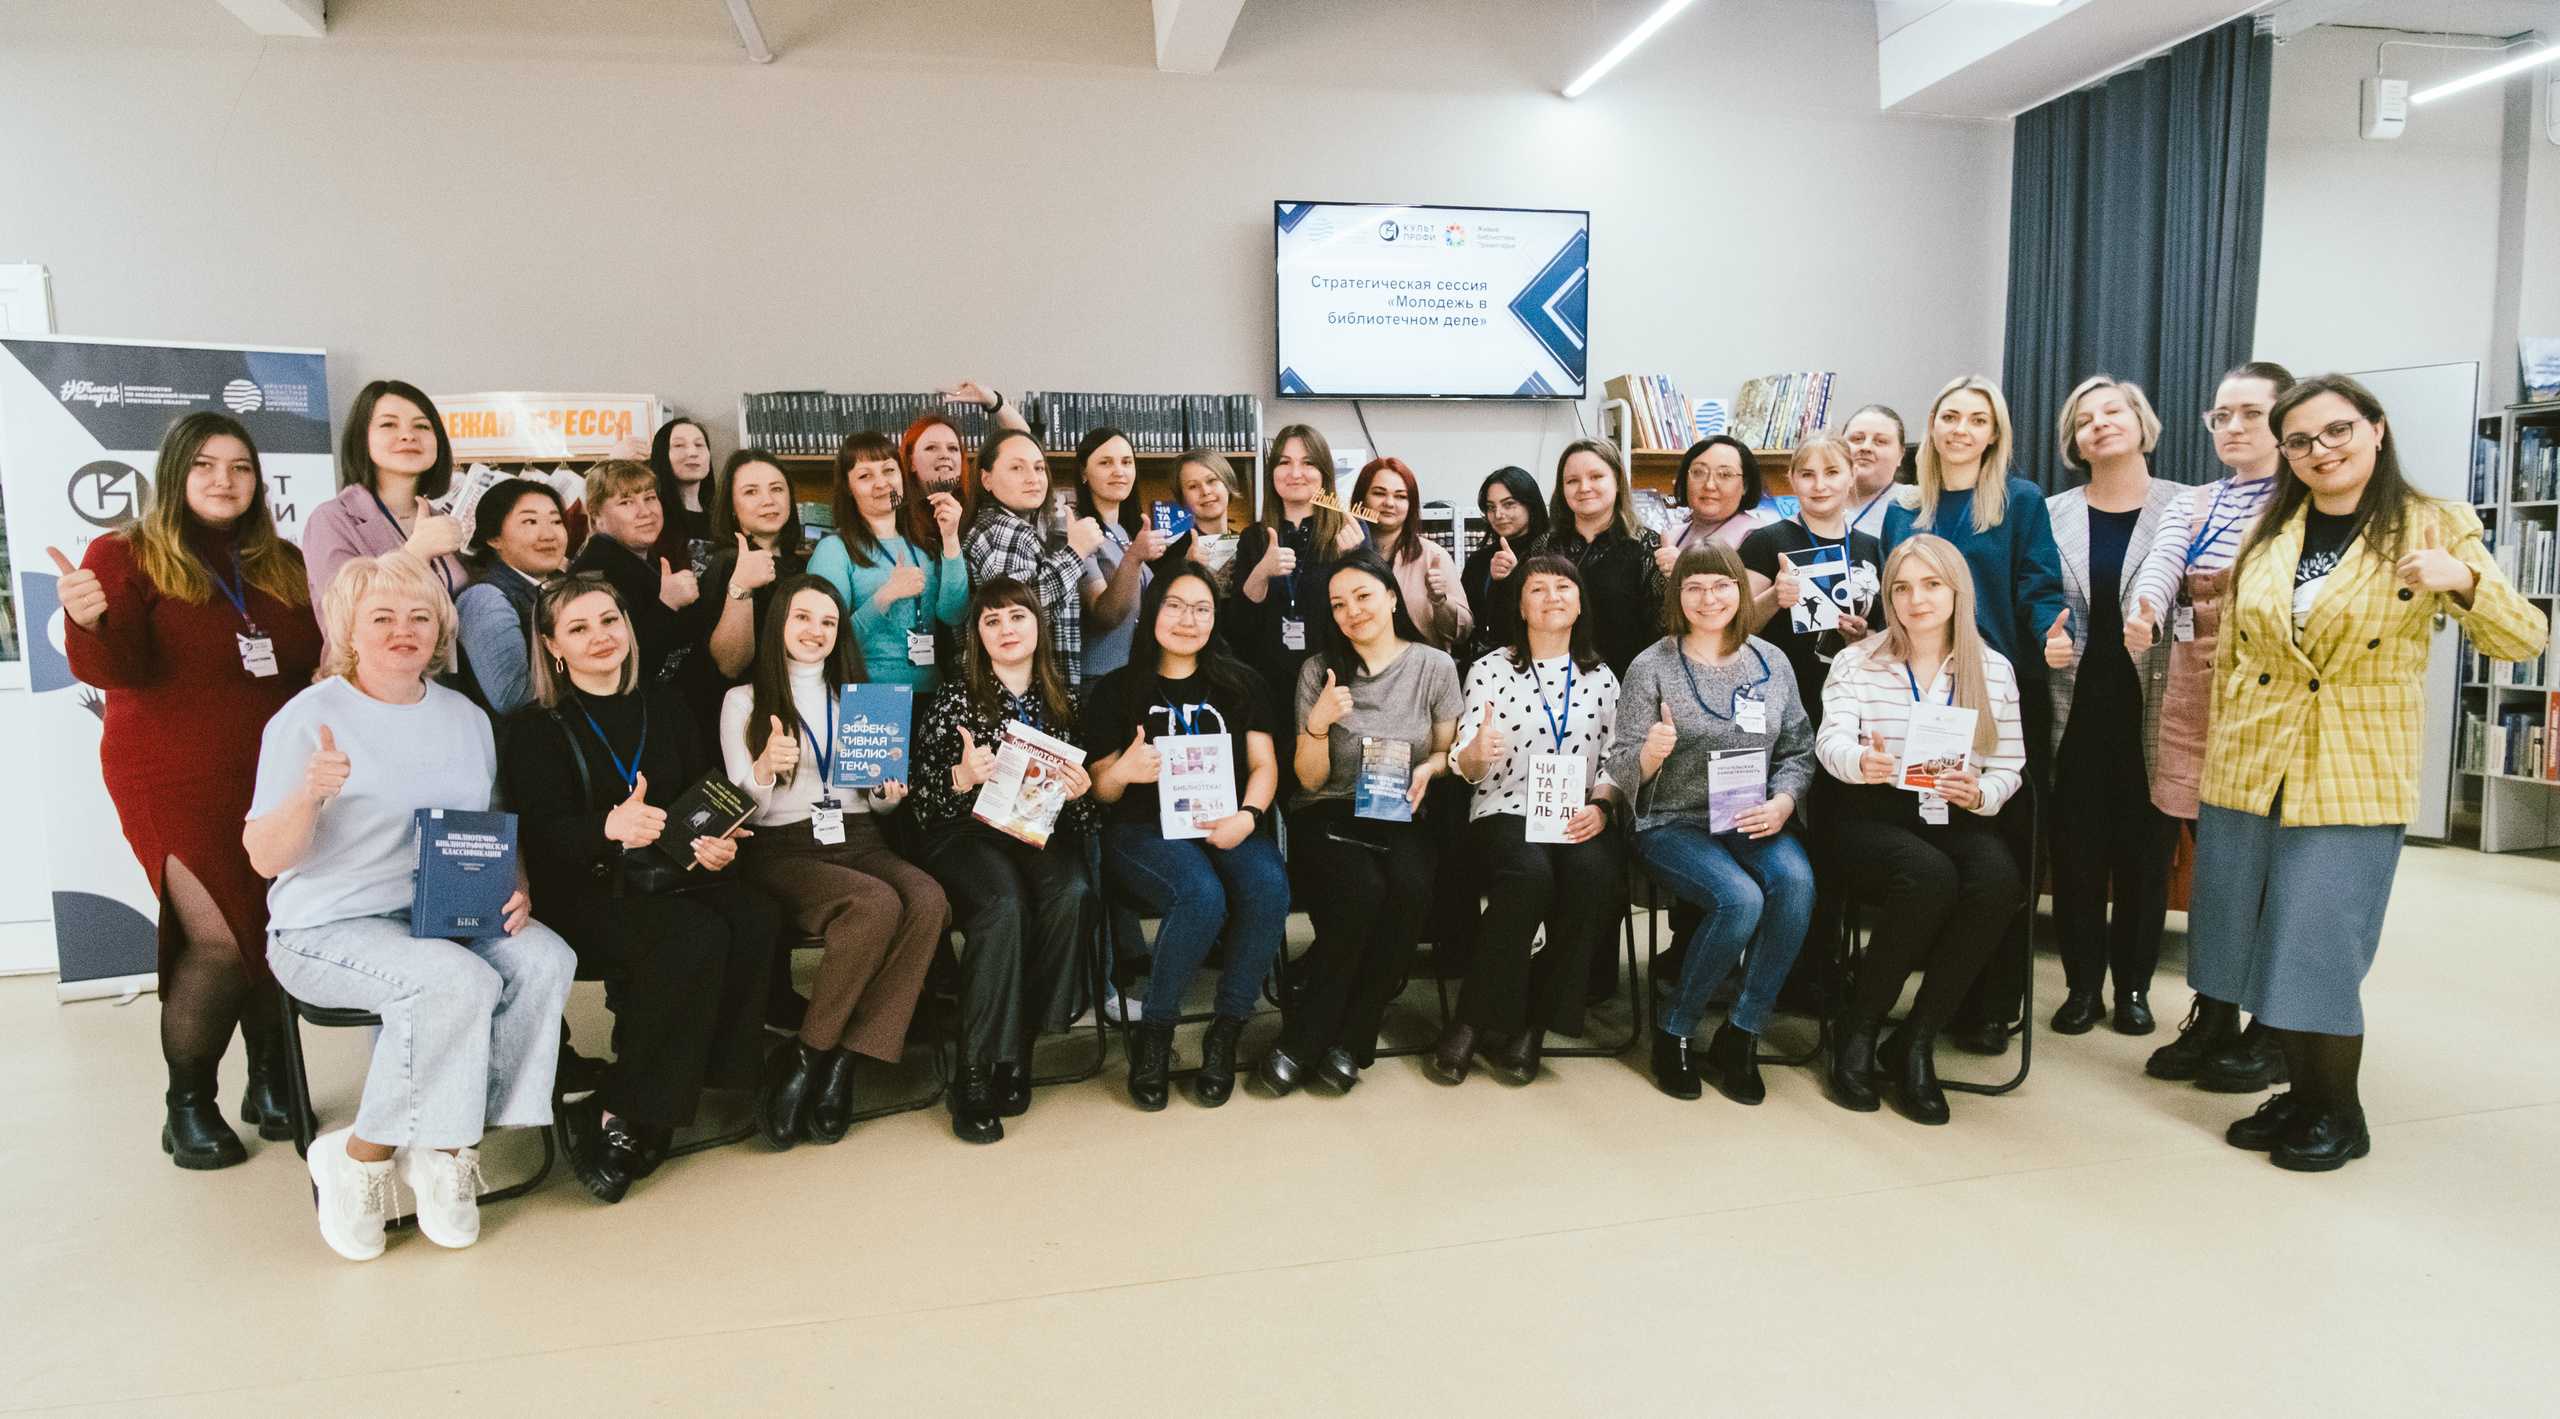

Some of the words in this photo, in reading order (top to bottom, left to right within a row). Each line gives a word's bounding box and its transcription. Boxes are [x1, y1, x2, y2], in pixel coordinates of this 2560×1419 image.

[1311, 276, 1431, 291] Стратегическая
[1437, 280, 1488, 292] сессия
[1388, 295, 1474, 310] «Молодежь
[1480, 300, 1487, 308] в
[1328, 312, 1438, 326] библиотечном
[1444, 315, 1487, 328] деле»
[440, 412, 516, 439] ЕЖАЯ
[531, 410, 632, 437] ПРЕССА
[842, 724, 886, 734] ЭФФЕК-
[842, 736, 887, 746] ТИВНАЯ
[840, 749, 890, 758] БИБЛИО-
[1012, 738, 1064, 766] библиотека
[840, 761, 868, 771] ТЕКА
[1536, 763, 1555, 774] ЧИ
[1568, 764, 1576, 775] В
[1536, 777, 1553, 788] ТА
[1562, 778, 1579, 789] ГО
[1536, 792, 1552, 802] ТЕ
[1561, 792, 1579, 804] РО
[1534, 806, 1553, 817] ЛЬ
[1560, 807, 1578, 820] ДЕ
[448, 833, 498, 842] БИБЛИОТЕЧНО-
[436, 840, 508, 851] БИБЛИОГРАФИЧЕСКАЯ
[442, 848, 501, 857] КЛАССИФИКАЦИЯ
[457, 918, 479, 926] ББК
